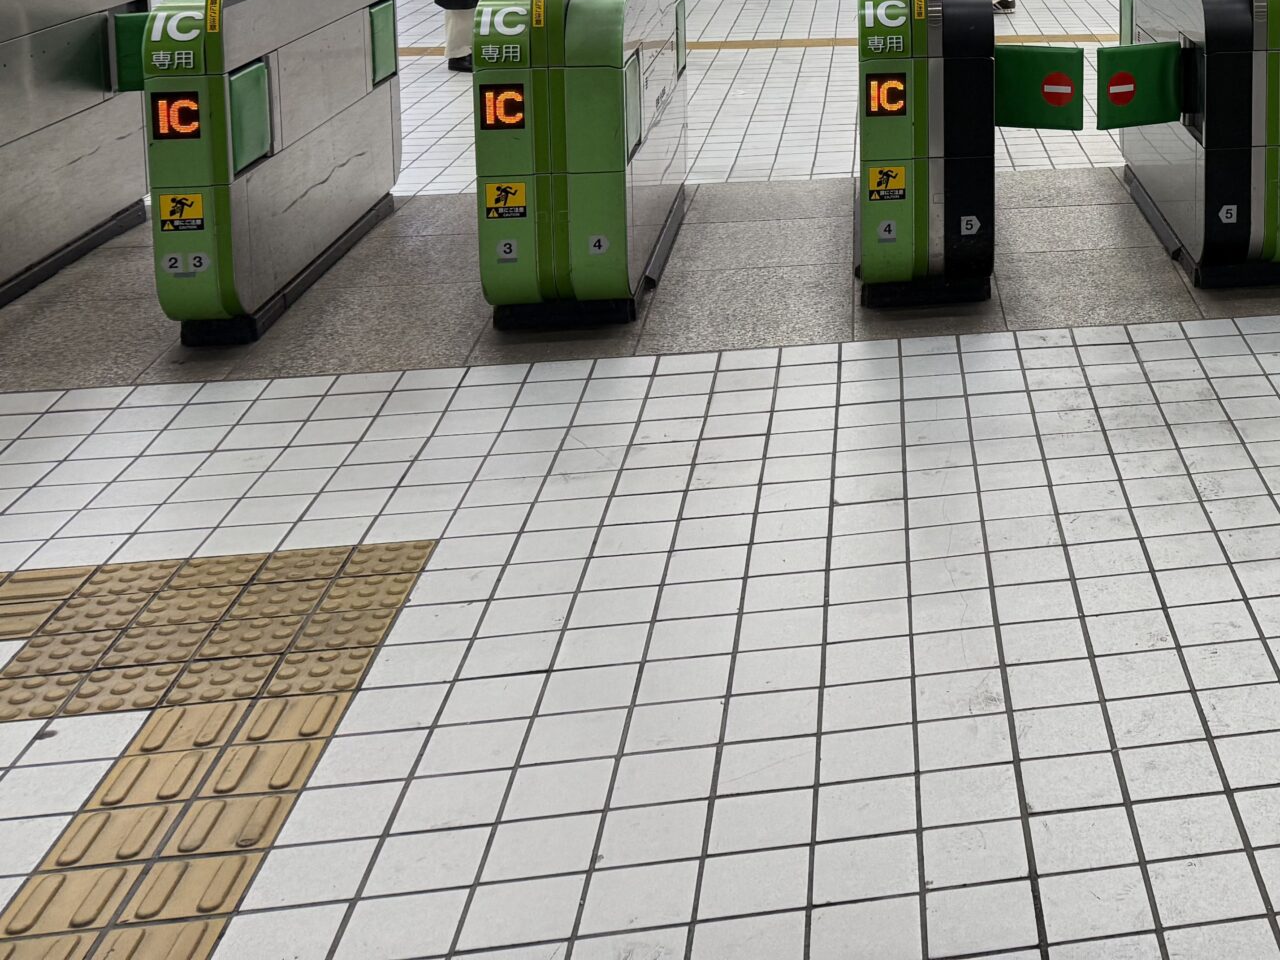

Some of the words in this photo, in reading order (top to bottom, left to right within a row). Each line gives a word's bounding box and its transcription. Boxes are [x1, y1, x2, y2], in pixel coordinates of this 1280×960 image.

[479, 6, 528, 36] IC
[864, 0, 906, 27] IC
[151, 11, 204, 41] IC
[867, 35, 903, 52] 専用
[151, 50, 193, 69] 専用
[481, 44, 520, 62] 専用
[870, 80, 904, 111] IC
[158, 99, 198, 133] IC
[486, 91, 523, 124] IC
[1225, 208, 1233, 219] 5
[884, 224, 892, 234] 4
[965, 220, 973, 230] 5
[503, 242, 513, 254] 3
[593, 238, 602, 250] 4
[168, 257, 178, 268] 2
[192, 256, 203, 267] 3
